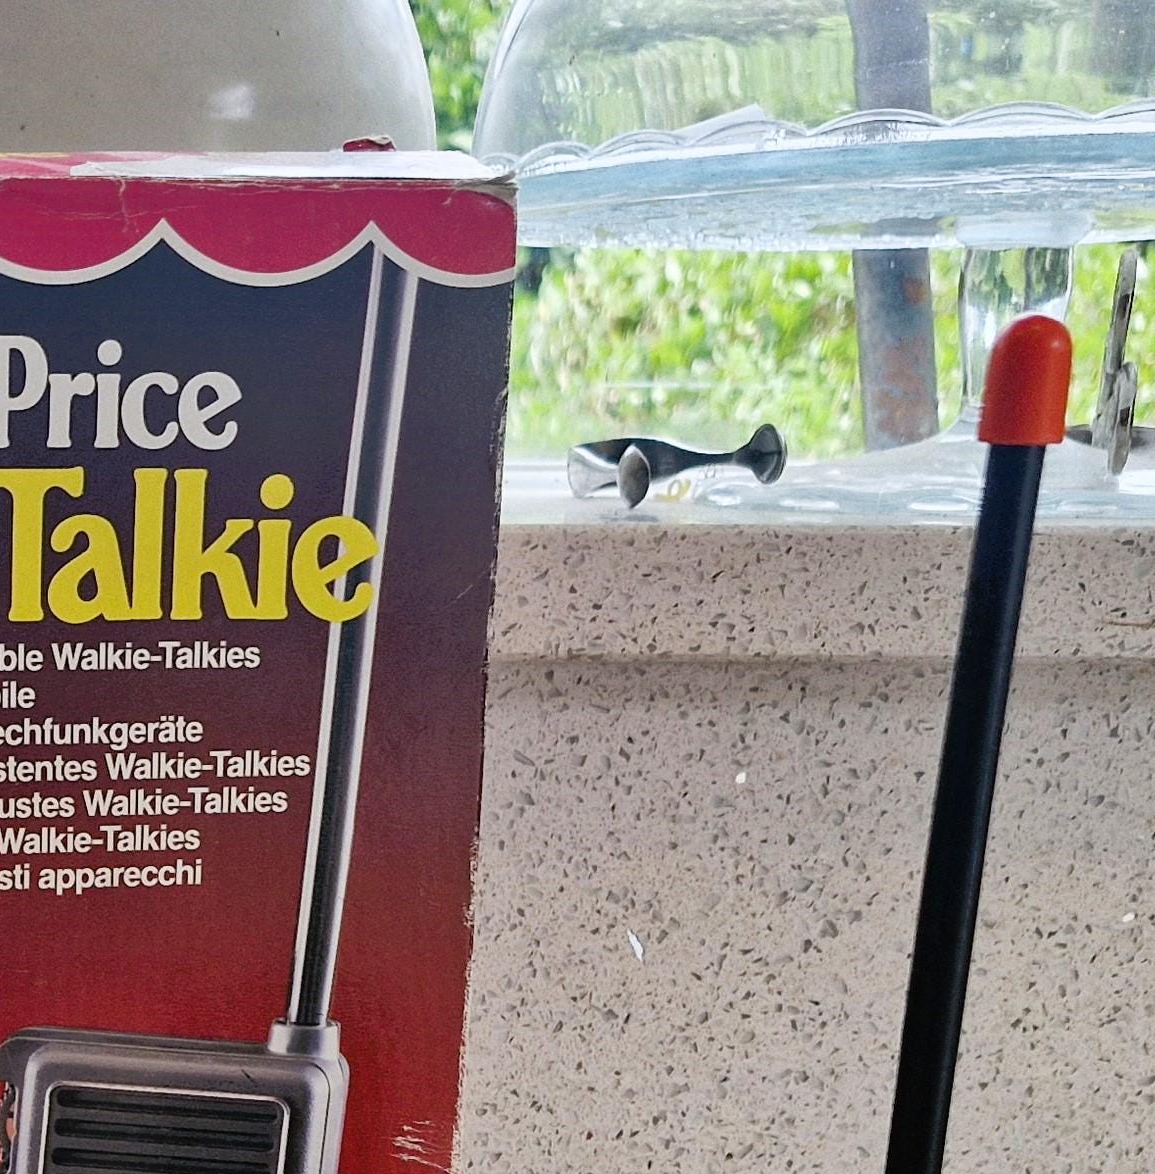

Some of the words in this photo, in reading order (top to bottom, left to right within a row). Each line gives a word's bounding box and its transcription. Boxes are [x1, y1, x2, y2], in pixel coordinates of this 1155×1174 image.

[51, 641, 261, 671] Walkie-Talkies
[105, 750, 311, 780] Walkie-Talkies
[83, 786, 288, 817] Walkie-Talkies
[39, 859, 203, 895] apparecchi
